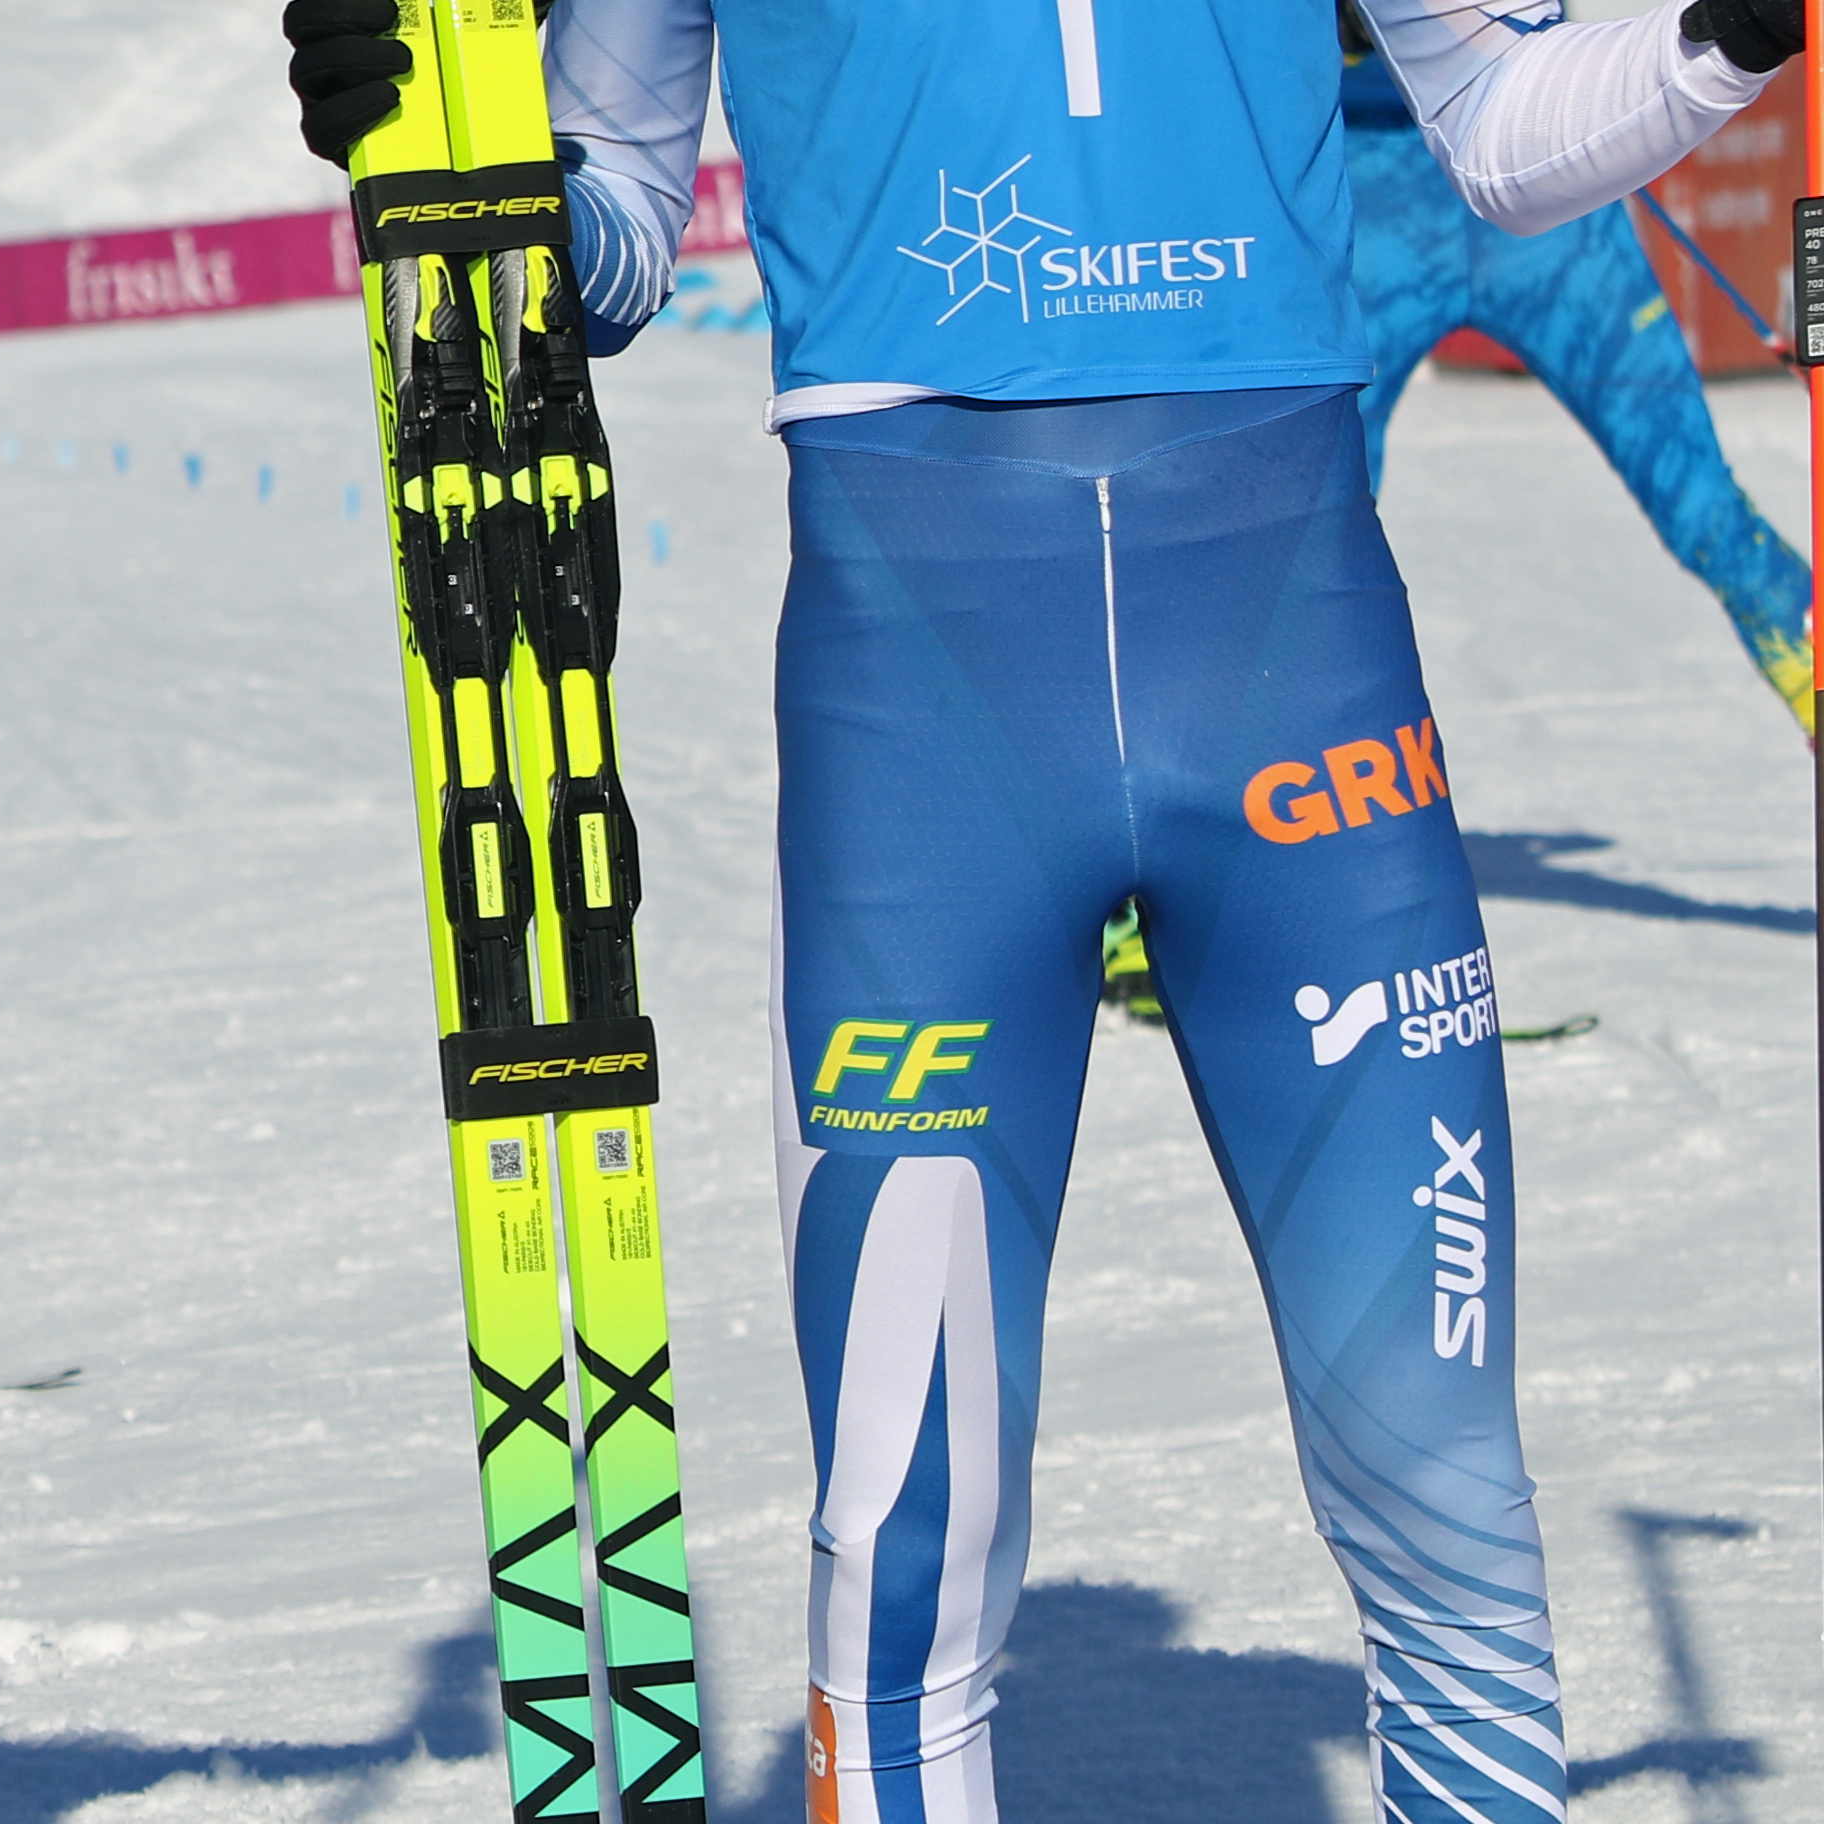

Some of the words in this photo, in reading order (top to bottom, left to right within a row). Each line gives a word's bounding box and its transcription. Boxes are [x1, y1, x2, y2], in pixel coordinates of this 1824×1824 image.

[375, 194, 562, 229] FISCHER
[1805, 228, 1824, 239] PRE
[1805, 240, 1821, 250] 40
[1039, 235, 1256, 292] SKIFEST
[1806, 256, 1818, 266] 78
[1042, 287, 1205, 320] LILLEHAMMER
[1242, 717, 1450, 845] GRK
[1394, 946, 1492, 1014] INTER
[1399, 995, 1499, 1062] SPORT
[468, 1052, 648, 1085] FISCHER
[810, 1017, 994, 1104] FF
